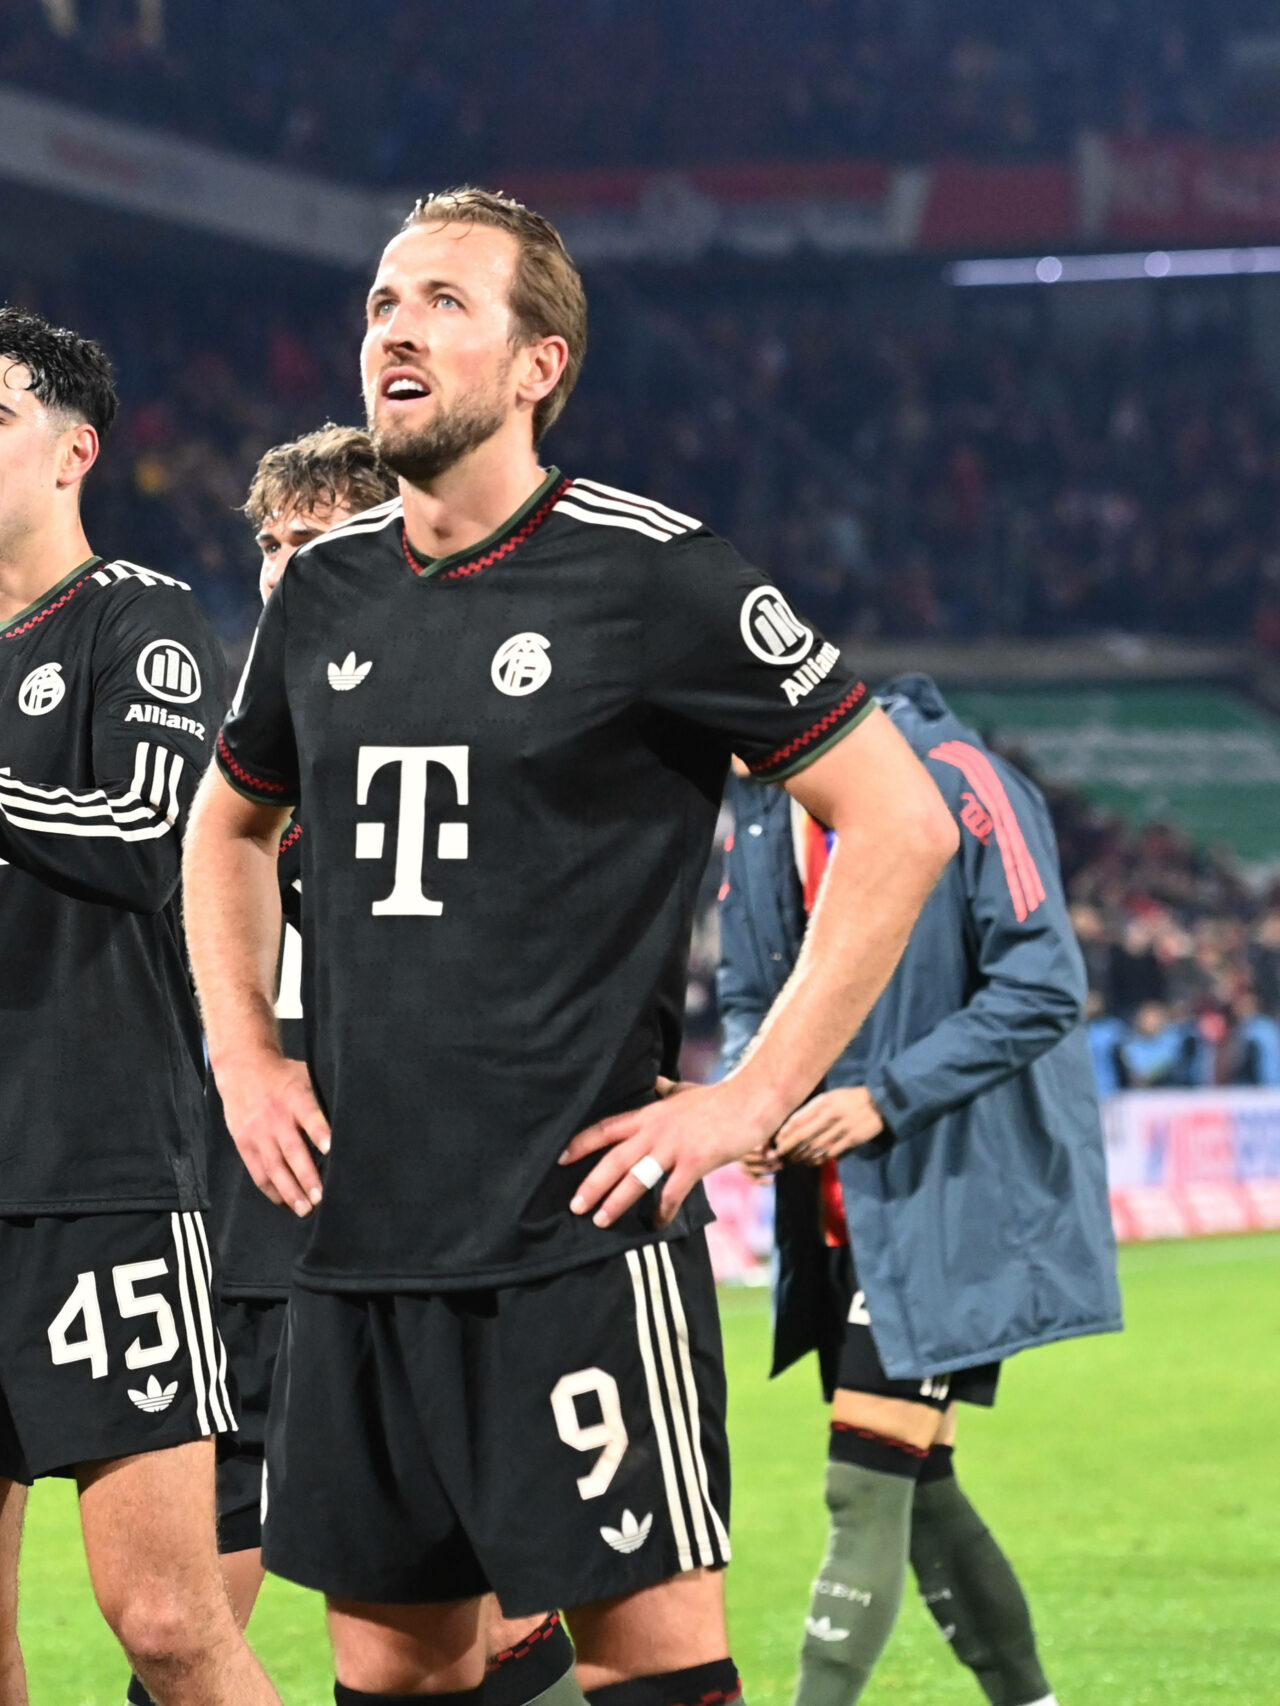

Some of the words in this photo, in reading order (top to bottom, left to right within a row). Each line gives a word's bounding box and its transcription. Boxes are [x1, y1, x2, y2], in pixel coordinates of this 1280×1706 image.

[124, 703, 206, 741] Allianz
[355, 745, 470, 917] T
[47, 1257, 179, 1380] 45
[550, 1367, 629, 1501] 9
